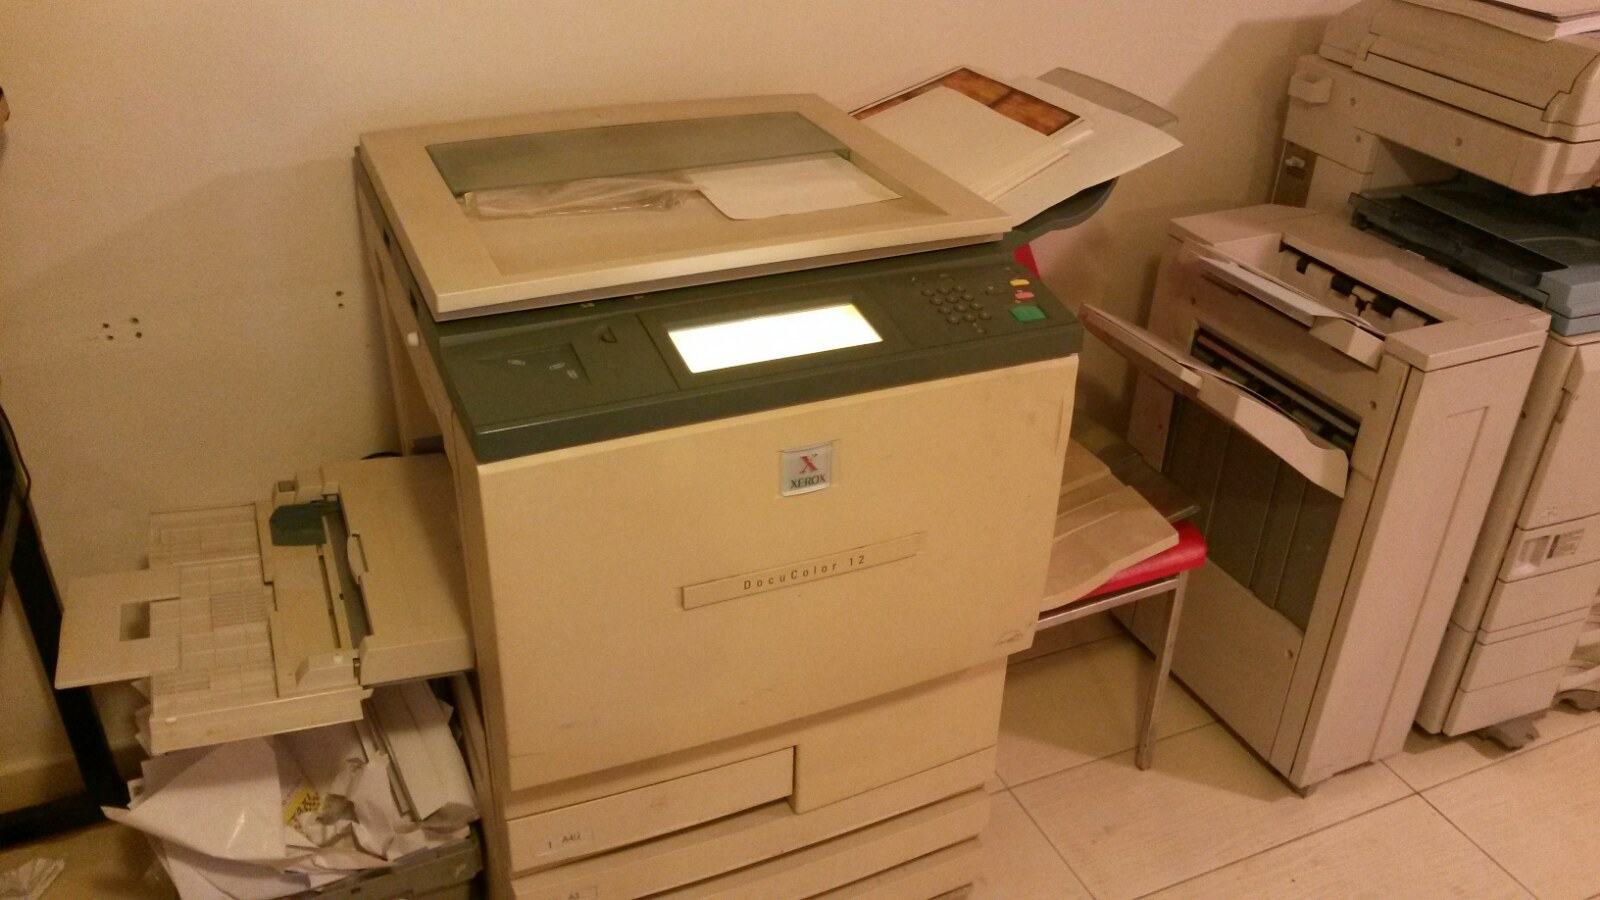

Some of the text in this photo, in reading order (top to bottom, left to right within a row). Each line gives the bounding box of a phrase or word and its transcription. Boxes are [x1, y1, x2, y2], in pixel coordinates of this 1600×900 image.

[790, 473, 826, 489] XEROX
[743, 554, 865, 590] DocuColor 12
